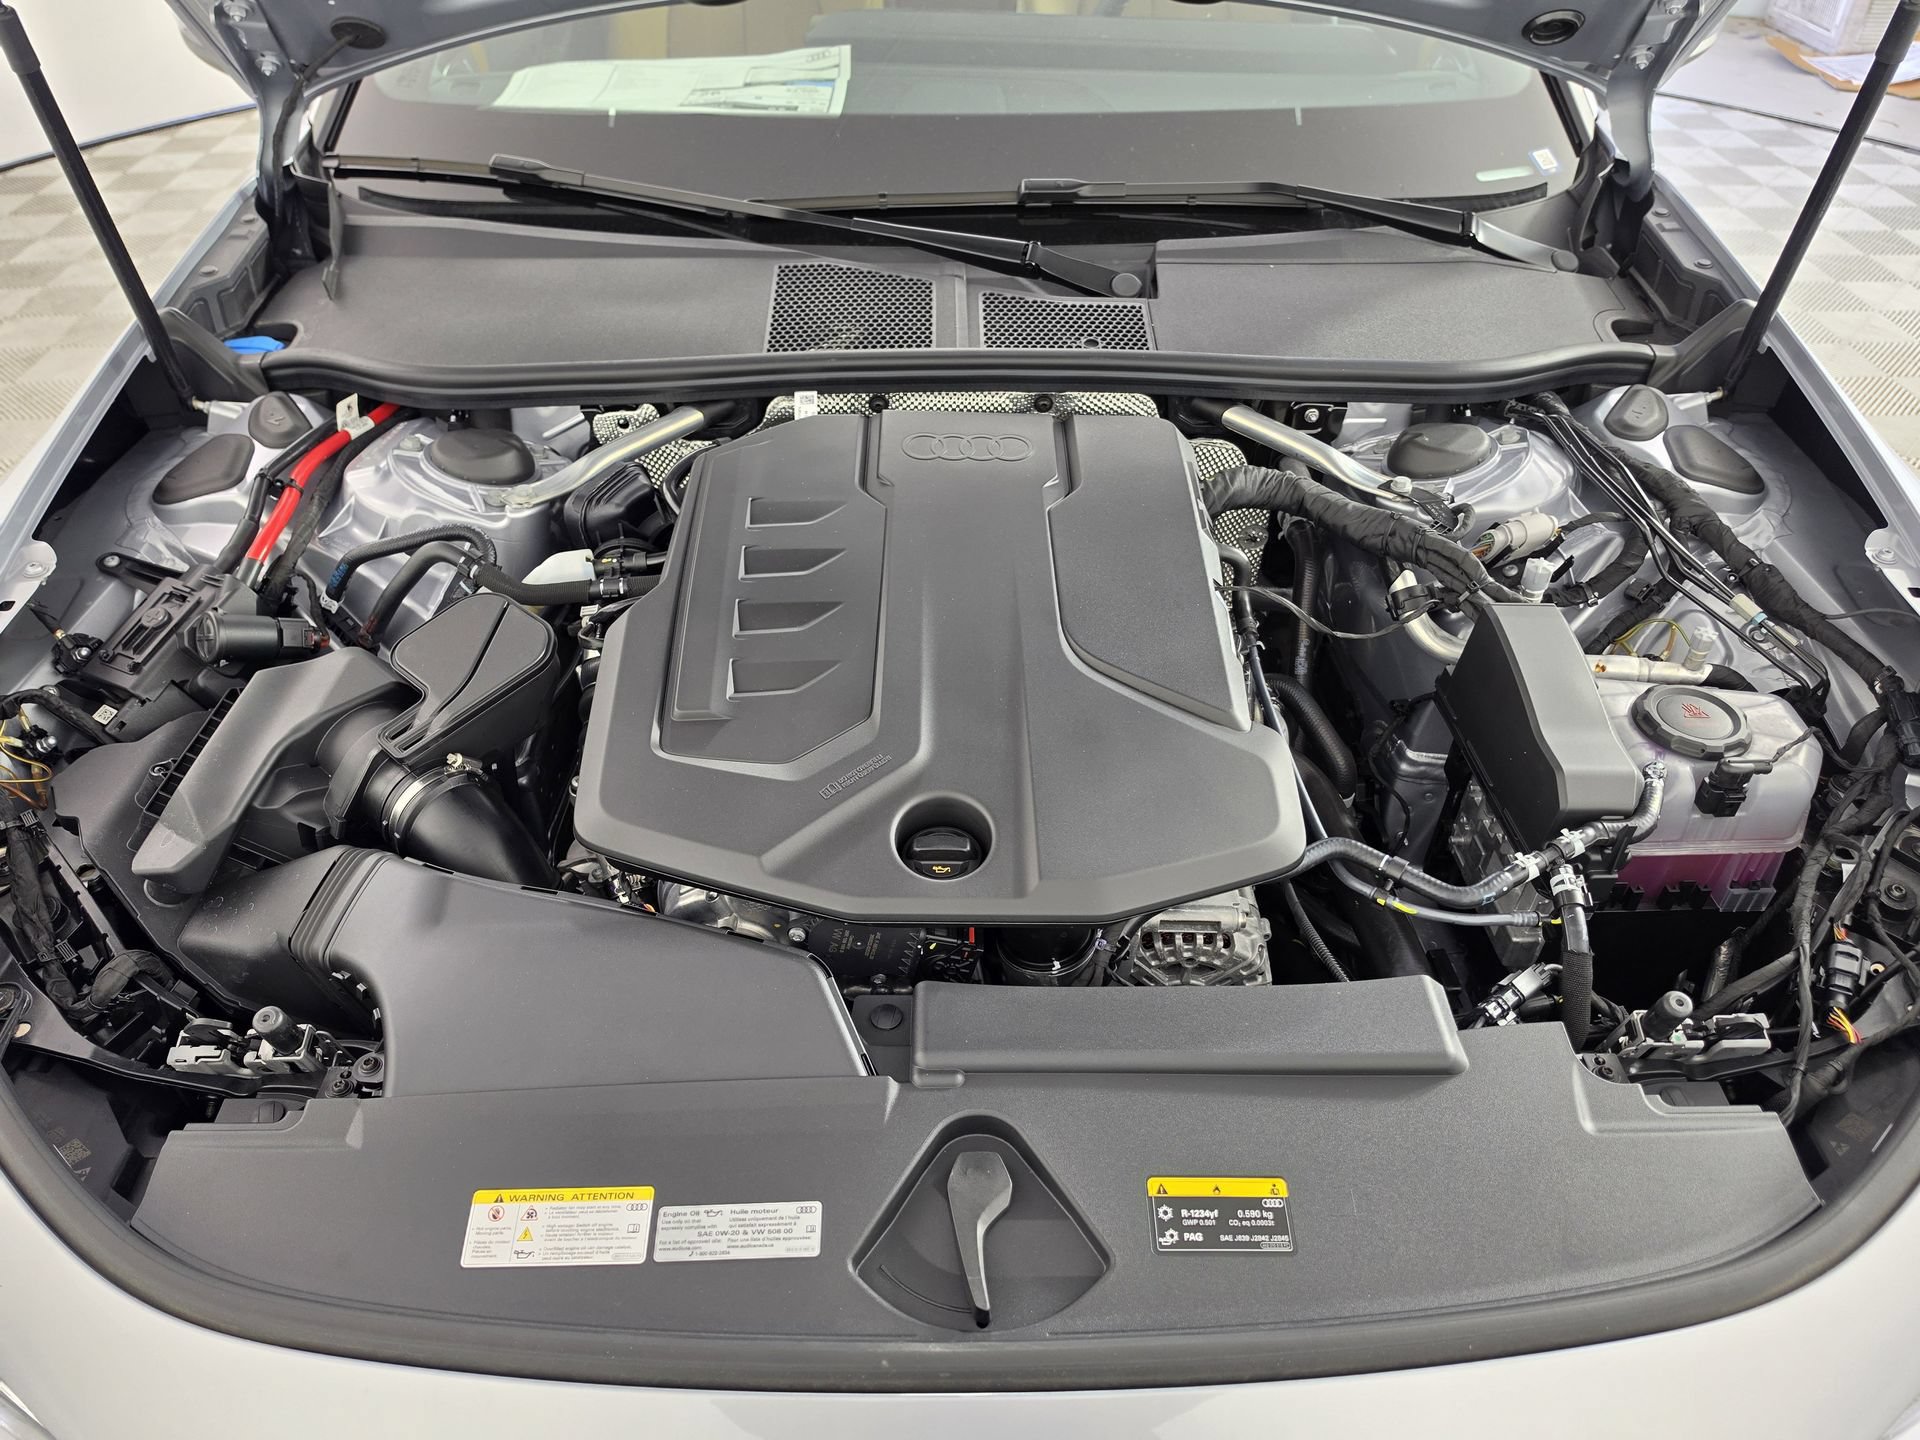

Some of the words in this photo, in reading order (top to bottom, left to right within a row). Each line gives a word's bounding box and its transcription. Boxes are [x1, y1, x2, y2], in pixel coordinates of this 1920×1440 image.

[509, 1193, 564, 1202] WARNING
[571, 1192, 634, 1200] ATTENTION
[1181, 1209, 1218, 1219] R-1234yf
[1262, 1210, 1274, 1219] kg
[1184, 1232, 1204, 1242] PAG
